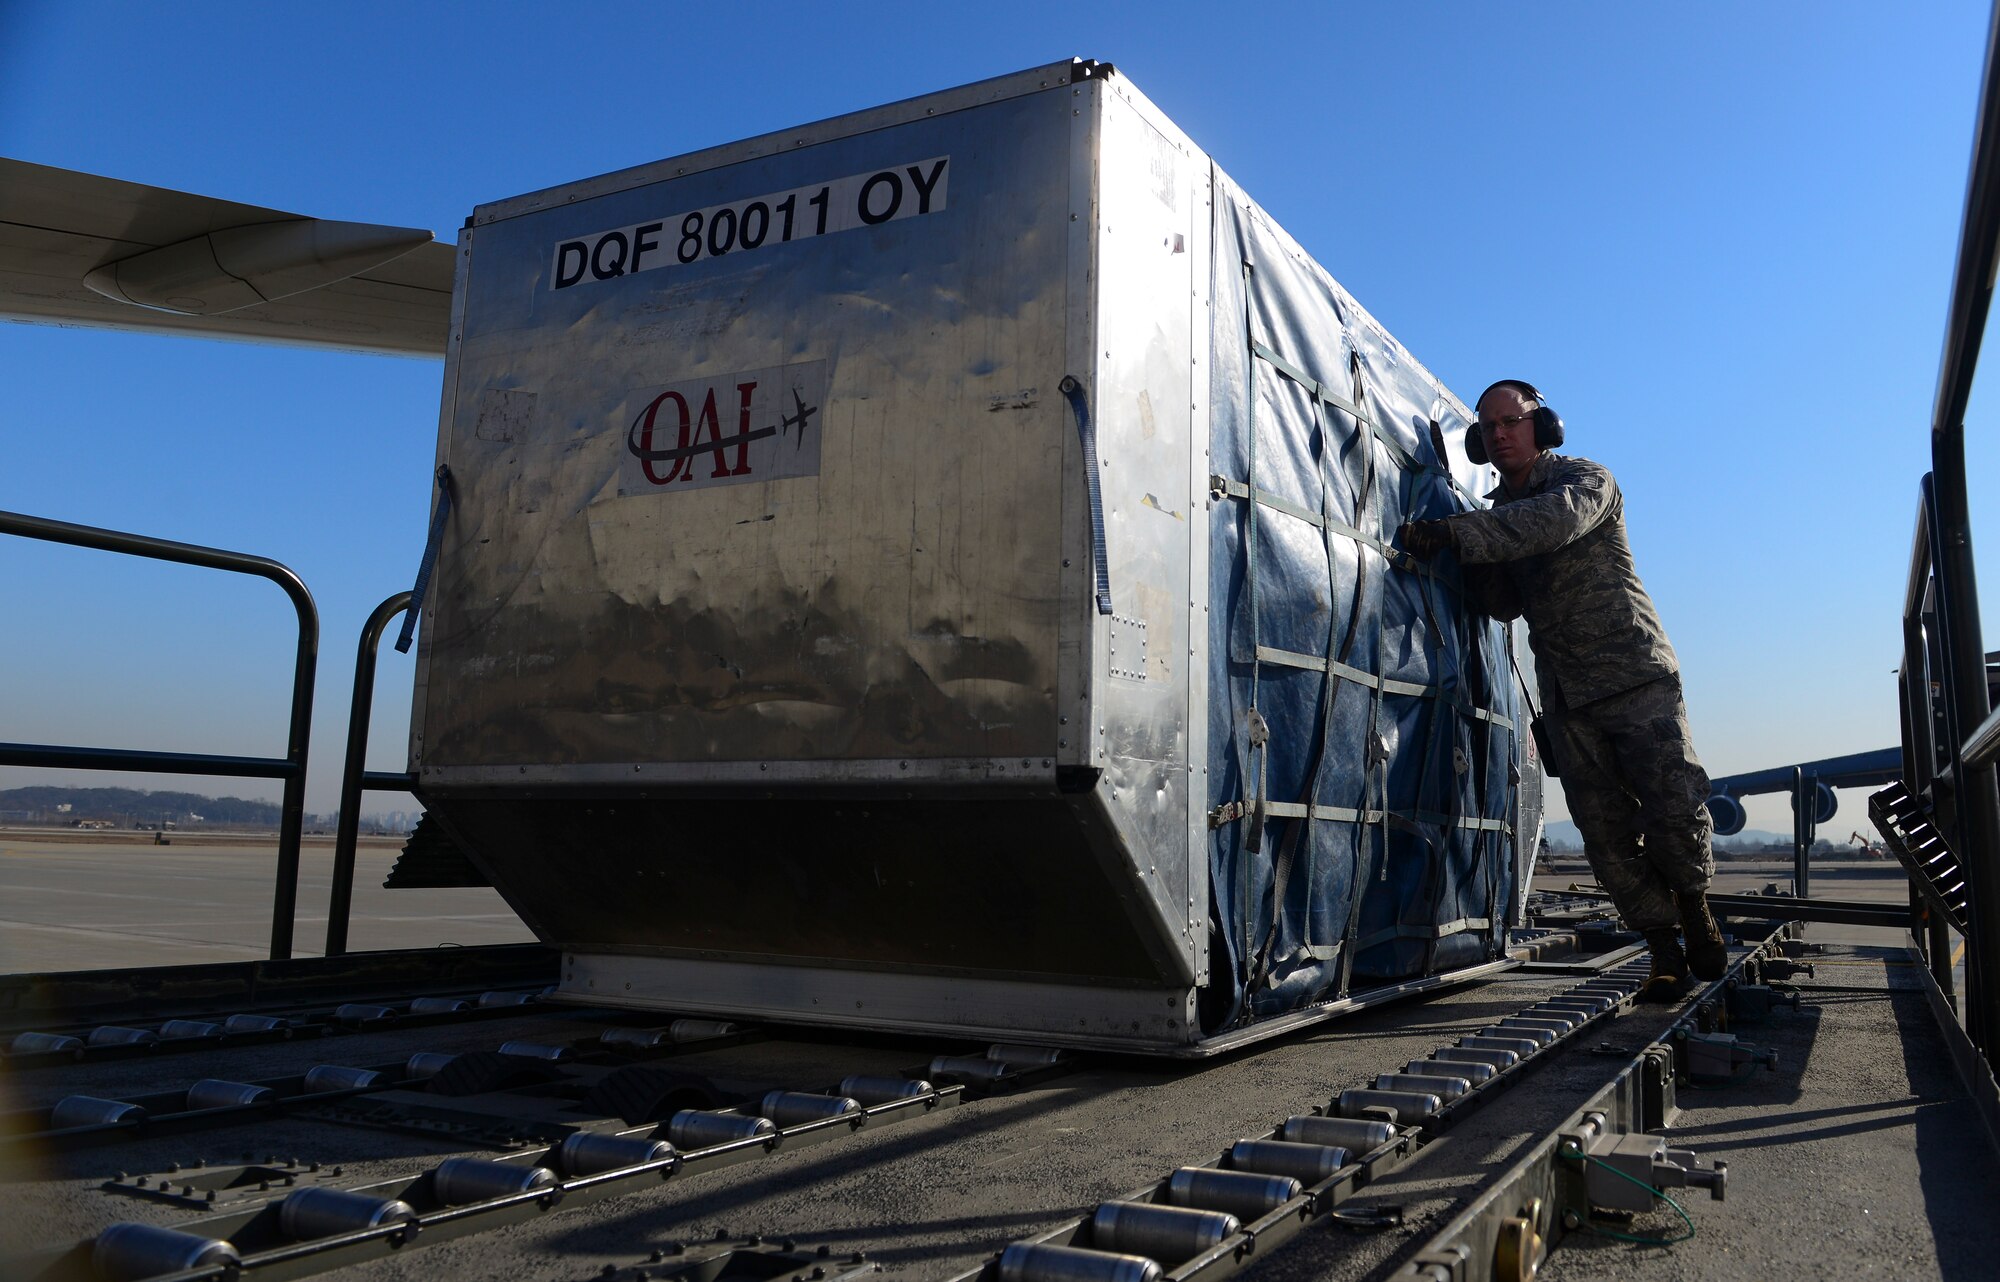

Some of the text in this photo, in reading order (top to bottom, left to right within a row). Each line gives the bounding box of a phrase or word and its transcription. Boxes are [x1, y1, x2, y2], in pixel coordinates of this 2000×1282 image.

[556, 159, 948, 289] DQF 80011 OY
[640, 381, 757, 485] OAI
